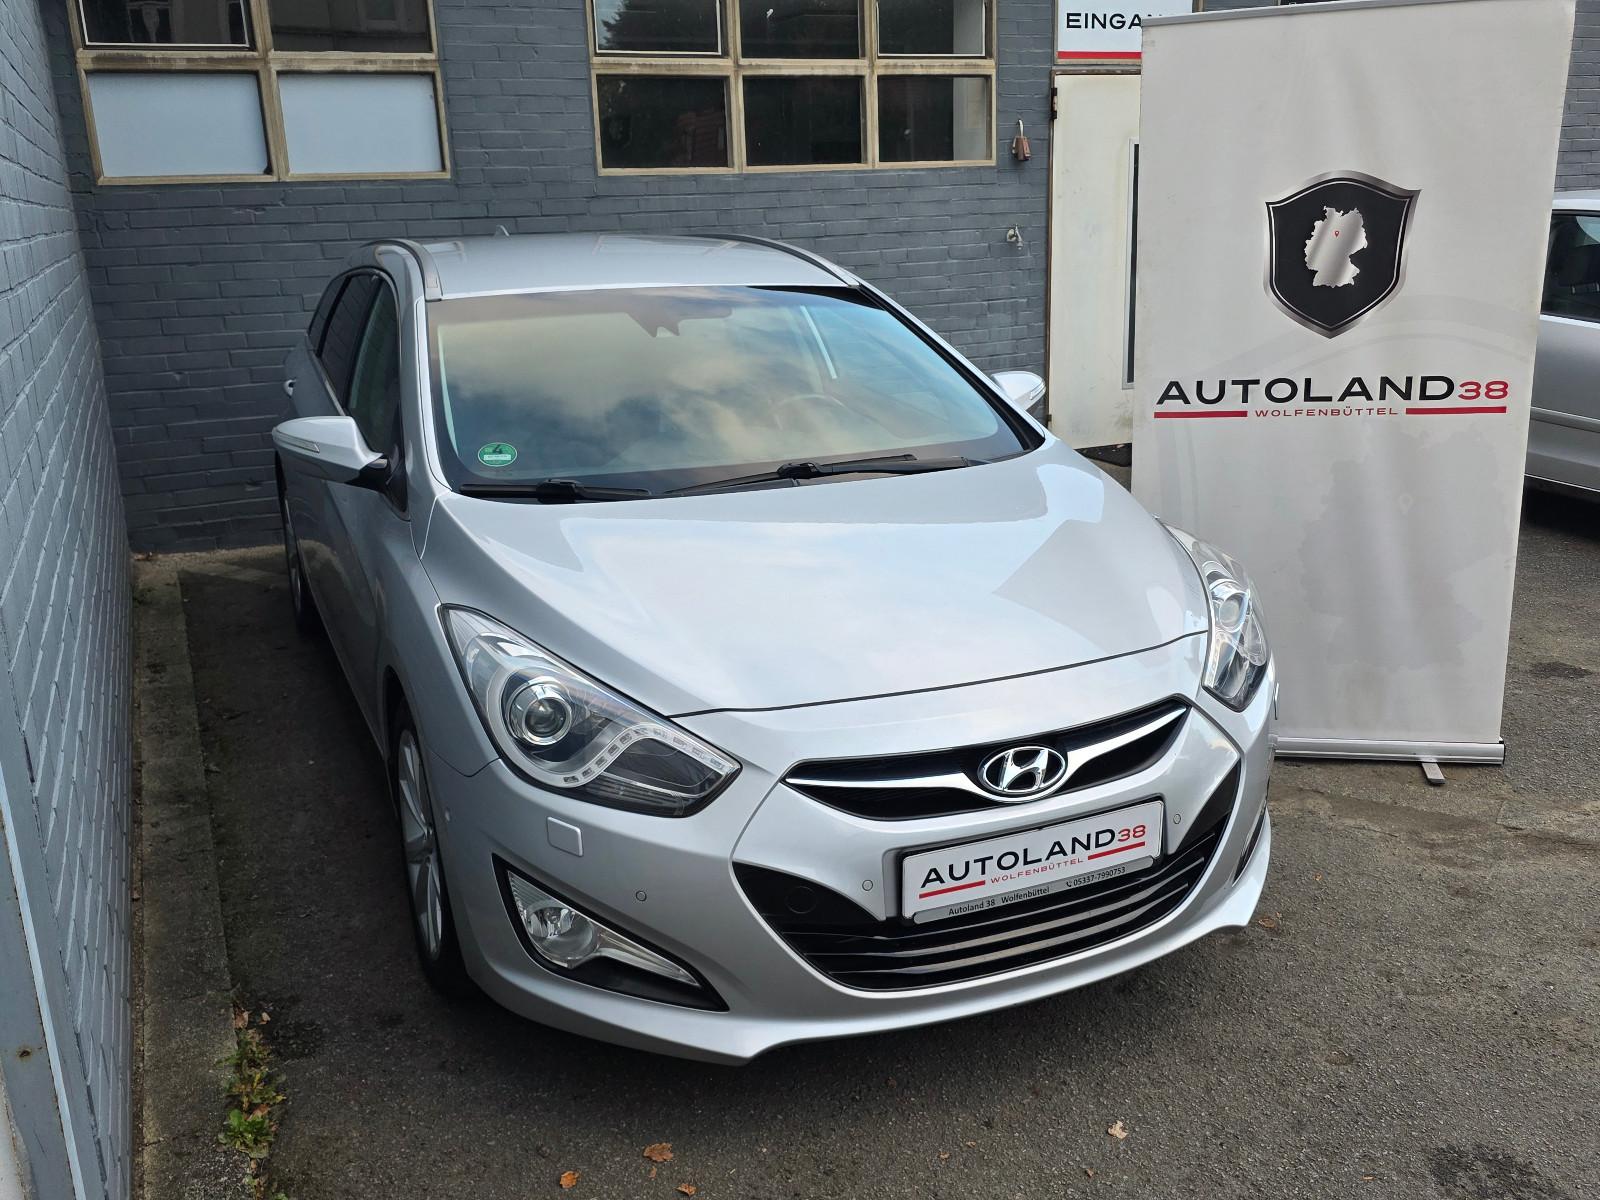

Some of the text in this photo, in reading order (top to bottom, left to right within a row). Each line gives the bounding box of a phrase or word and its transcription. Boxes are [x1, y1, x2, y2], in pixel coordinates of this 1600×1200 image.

[1066, 12, 1163, 30] EINGA
[1156, 375, 1509, 405] AUTOLAND38
[1255, 406, 1399, 418] WOLFENBÜTTEL
[920, 824, 1147, 889] AUTOLAND38
[990, 857, 1084, 884] WOLFENBÜTTEL
[948, 866, 1126, 916] Autoland 38 Wolfenbüttel 05337-7990753
